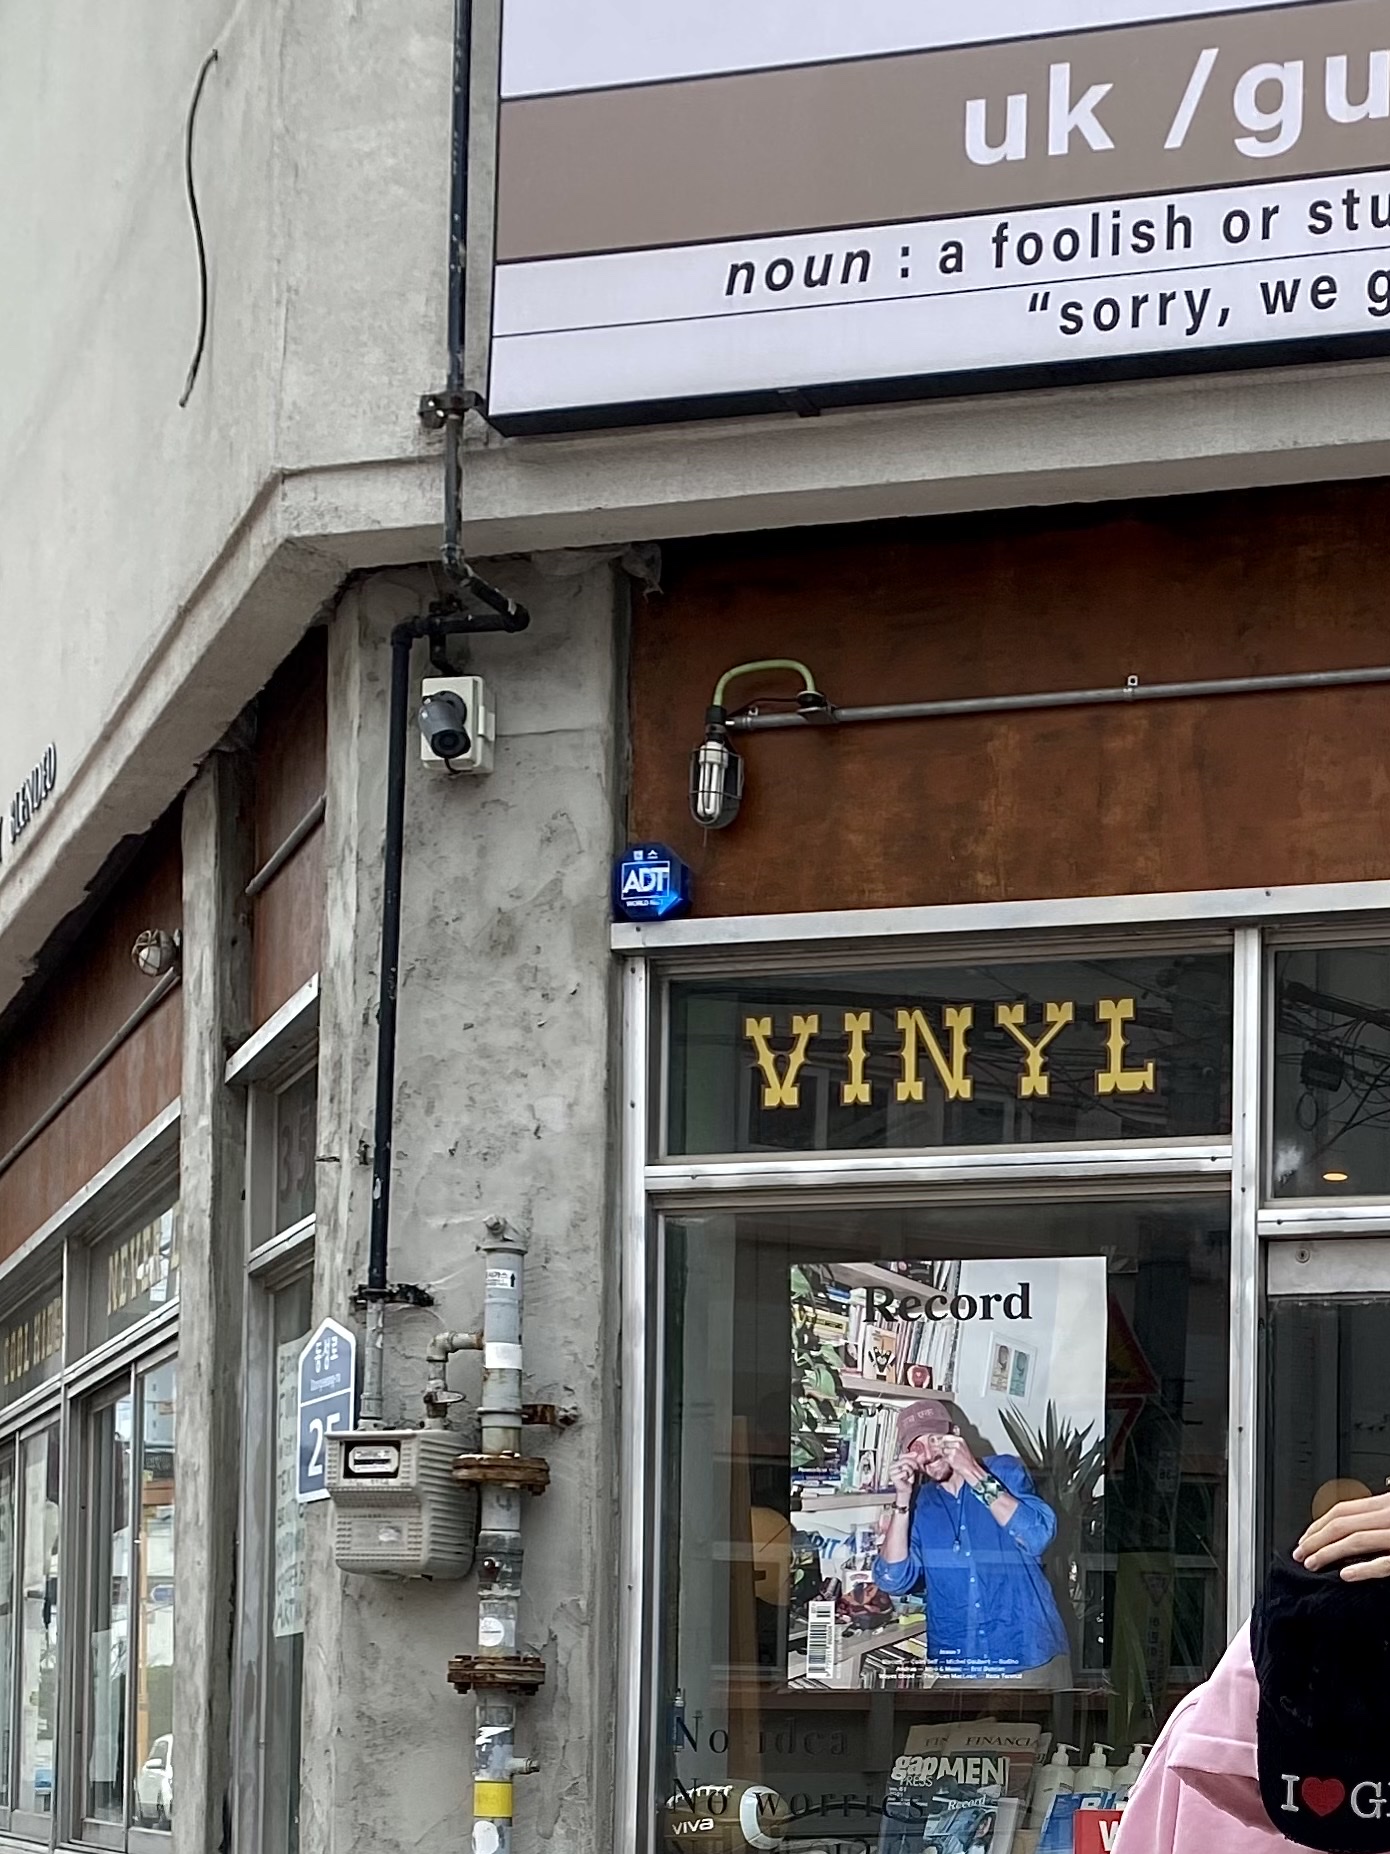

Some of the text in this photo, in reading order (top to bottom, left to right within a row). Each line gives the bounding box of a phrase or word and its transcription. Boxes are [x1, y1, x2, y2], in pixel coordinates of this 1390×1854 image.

[964, 62, 1115, 166] uk
[725, 250, 871, 297] noun
[938, 240, 963, 275] a
[991, 204, 1193, 269] foolish
[1222, 205, 1280, 244] or
[1259, 274, 1337, 315] we
[622, 867, 669, 894] ADT
[744, 997, 1156, 1110] VINYL
[862, 1282, 1033, 1324] Record
[675, 1713, 848, 1755] No idea
[891, 1755, 1004, 1785] gap MEN
[673, 1777, 728, 1816] No
[754, 1788, 925, 1819] worries
[1280, 1773, 1300, 1813] I
